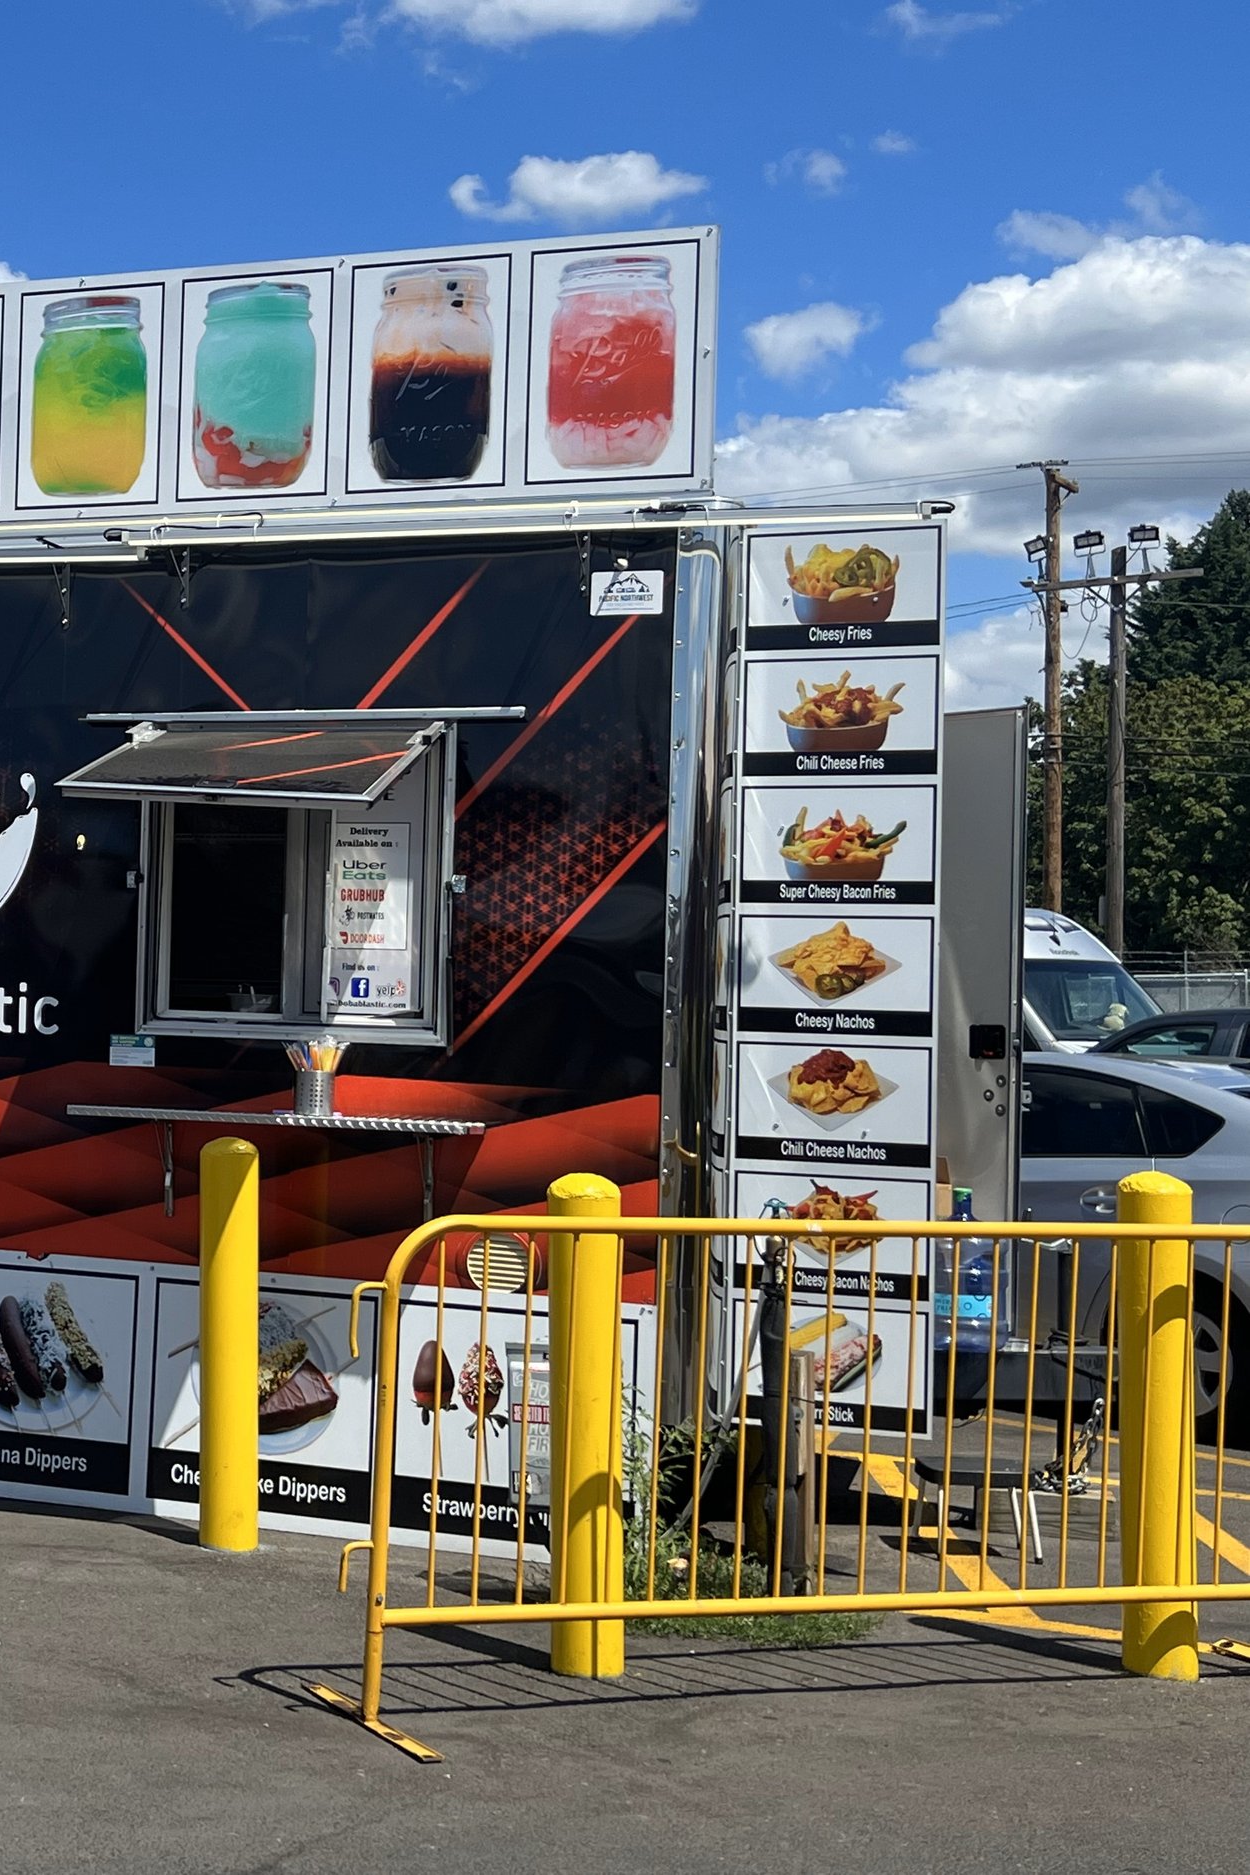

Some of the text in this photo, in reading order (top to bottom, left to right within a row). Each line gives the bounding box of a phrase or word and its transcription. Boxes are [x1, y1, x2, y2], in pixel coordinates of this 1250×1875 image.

[809, 625, 873, 644] Cheesy Fries
[796, 754, 885, 770] Chili Cheese Fries
[350, 827, 389, 837] Delivery
[335, 839, 379, 848] Available
[380, 840, 393, 848] on
[342, 859, 388, 870] Uber
[342, 870, 387, 881] Eats
[340, 888, 385, 902] GRUBHUB
[780, 884, 897, 902] Super Cheesy Bacon Fries
[350, 934, 385, 945] DOORDASH
[342, 963, 357, 971] Find
[795, 1012, 876, 1031] Cheesy Nachos
[781, 1140, 887, 1160] Chili Cheese Nachos
[794, 1271, 828, 1290] Cheesy
[832, 1274, 859, 1289] acon
[828, 1405, 854, 1423] Stick
[24, 1446, 88, 1474] Dippers
[278, 1475, 347, 1504] Dippers
